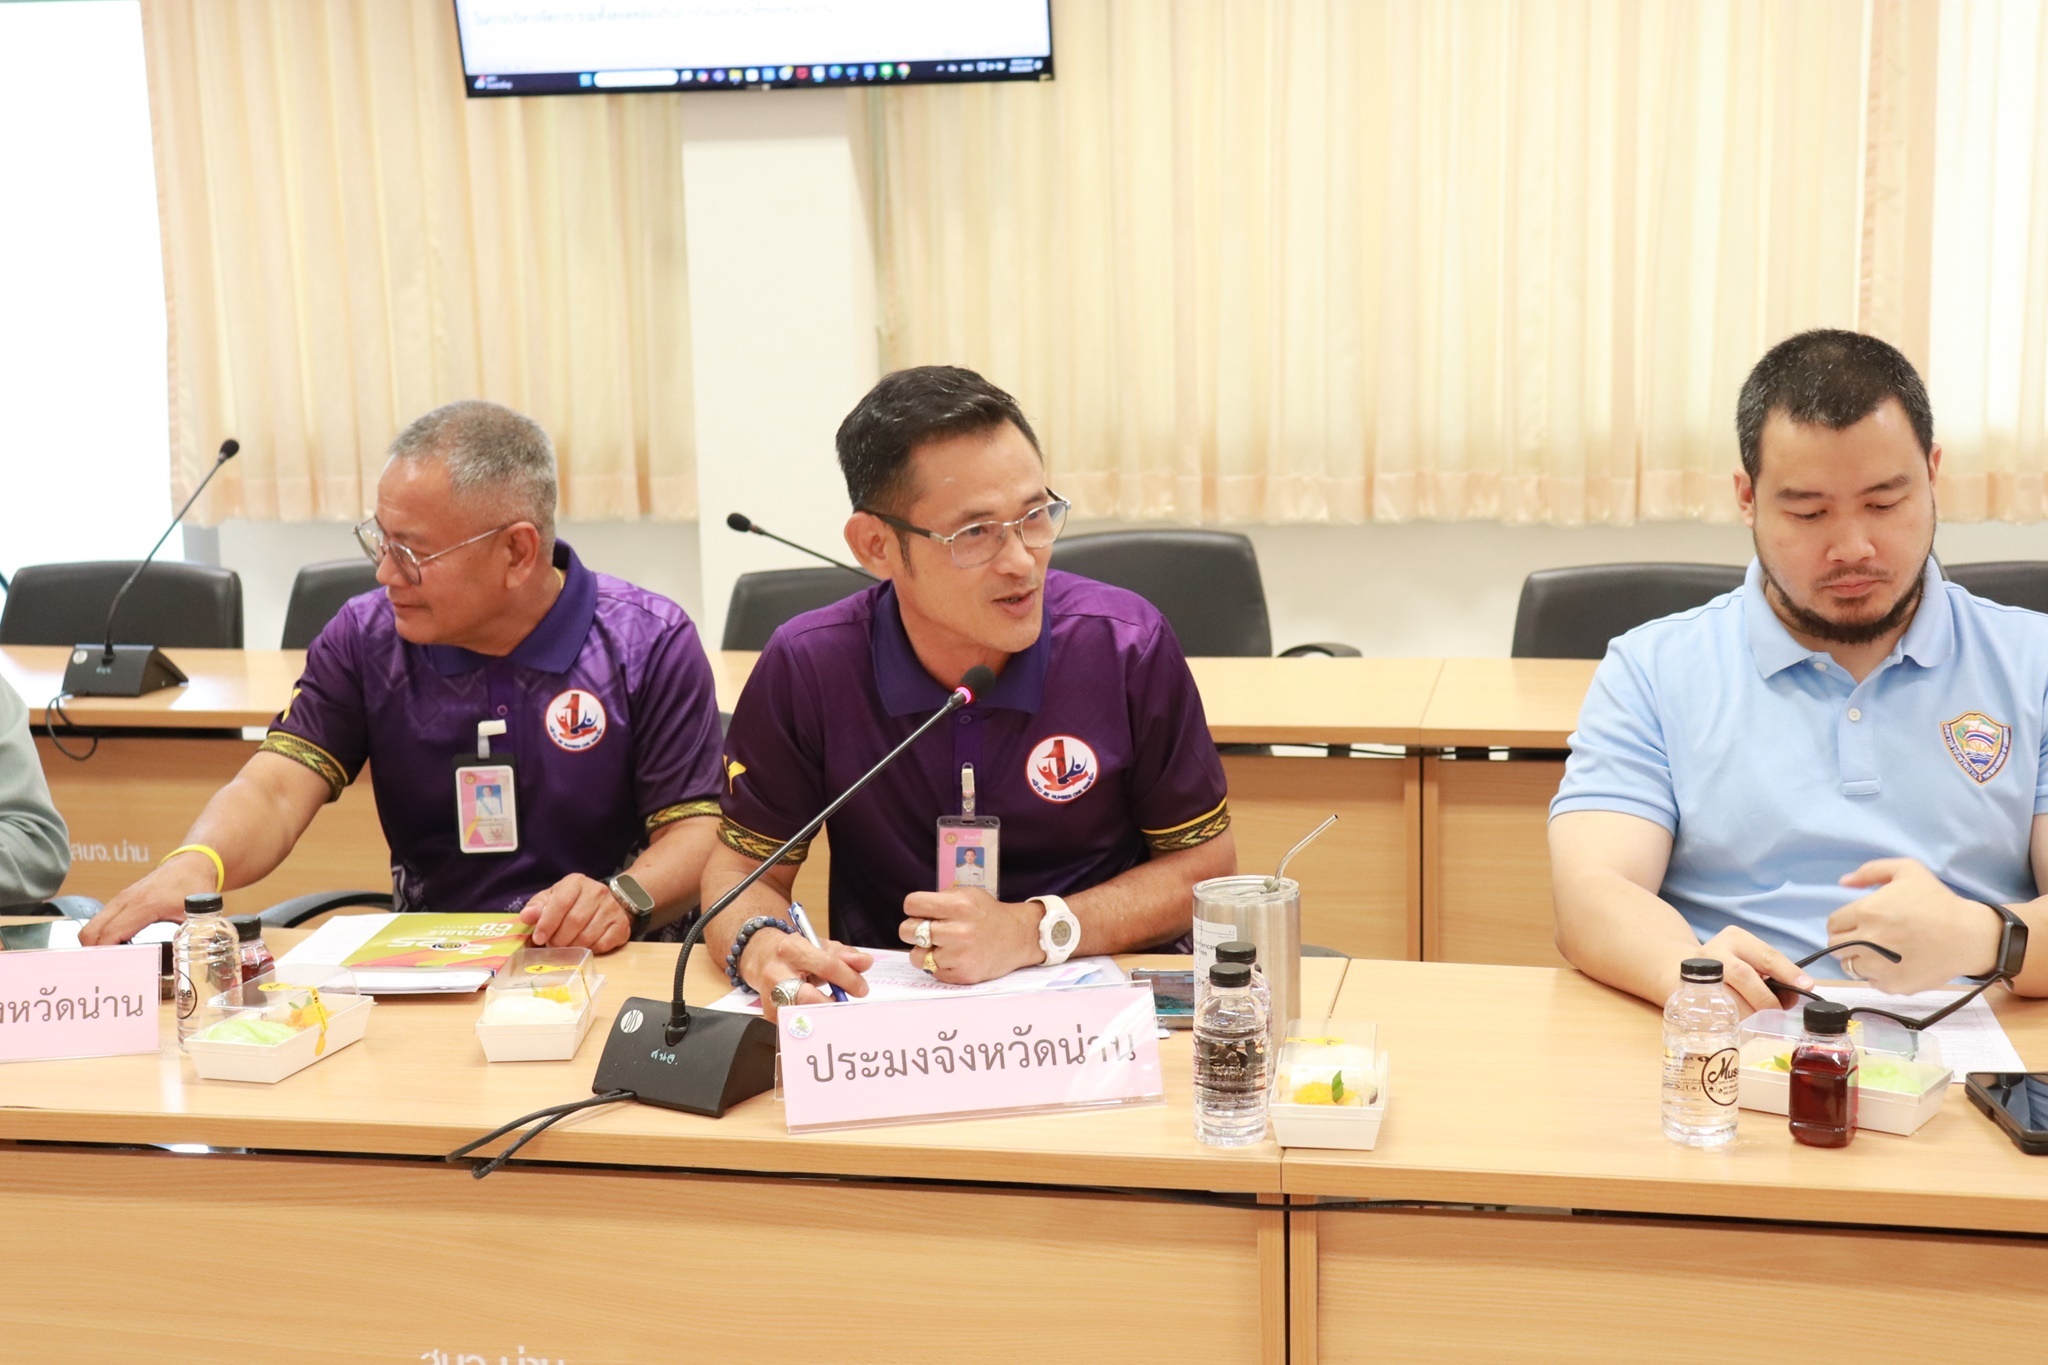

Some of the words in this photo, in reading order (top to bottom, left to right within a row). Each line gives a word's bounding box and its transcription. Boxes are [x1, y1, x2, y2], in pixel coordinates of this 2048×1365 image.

[429, 929, 507, 937] PORTABLE
[478, 923, 514, 931] CD
[0, 986, 144, 1024] หวัดน่าน
[806, 1023, 1137, 1083] ประมงจังหวัดน่าน
